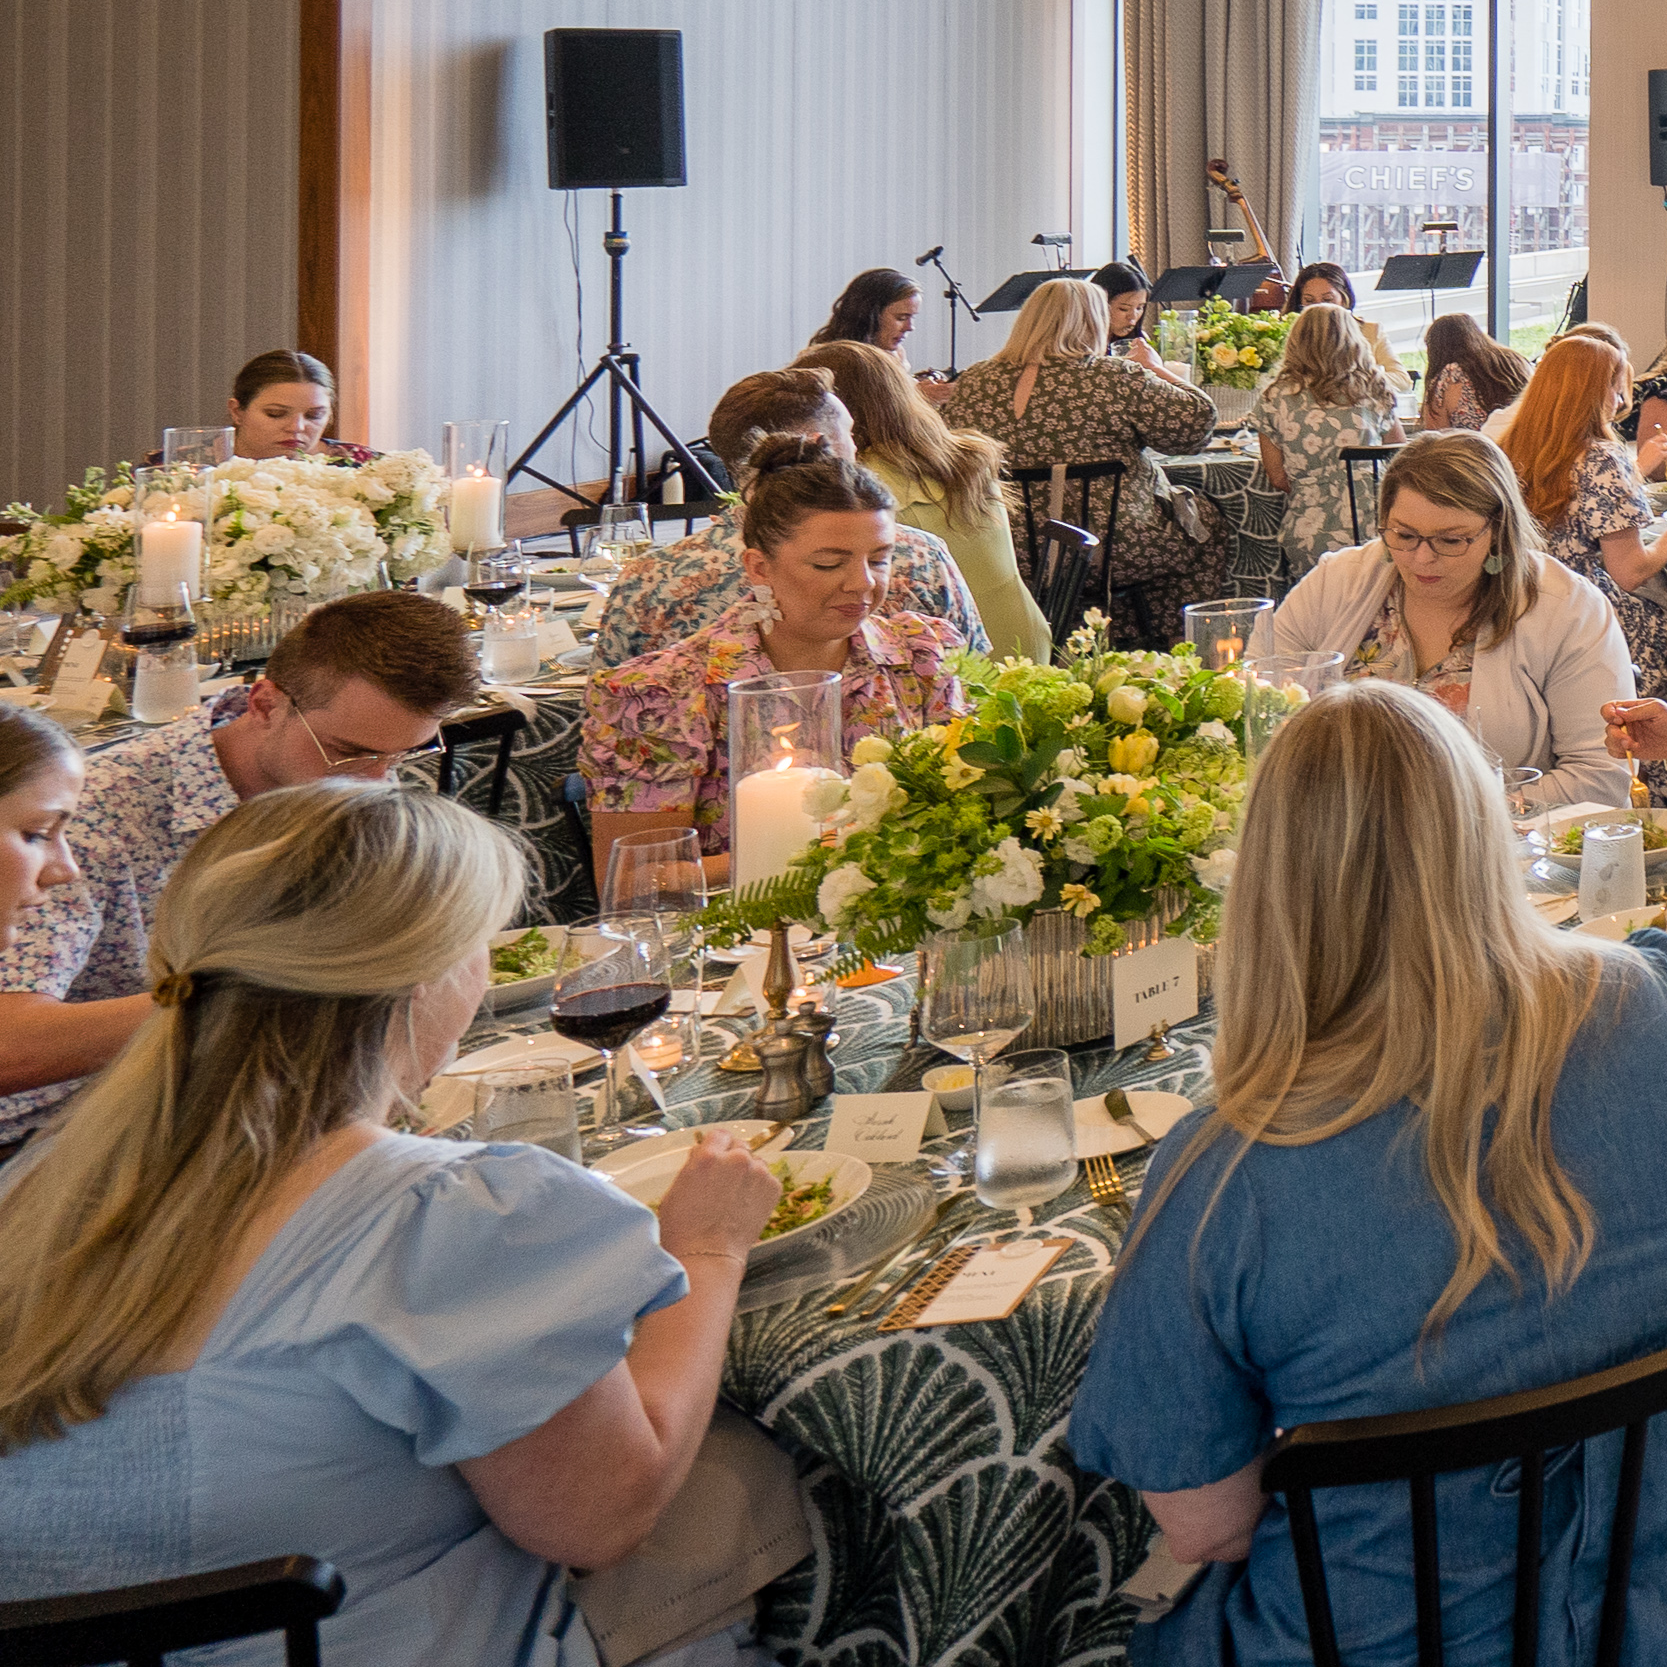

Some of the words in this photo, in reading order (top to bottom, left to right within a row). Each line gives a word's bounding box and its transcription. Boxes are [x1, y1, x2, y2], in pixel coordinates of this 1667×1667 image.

[1343, 165, 1475, 192] CHIEF'S
[1133, 979, 1169, 1003] TABLE
[1172, 975, 1180, 987] 7
